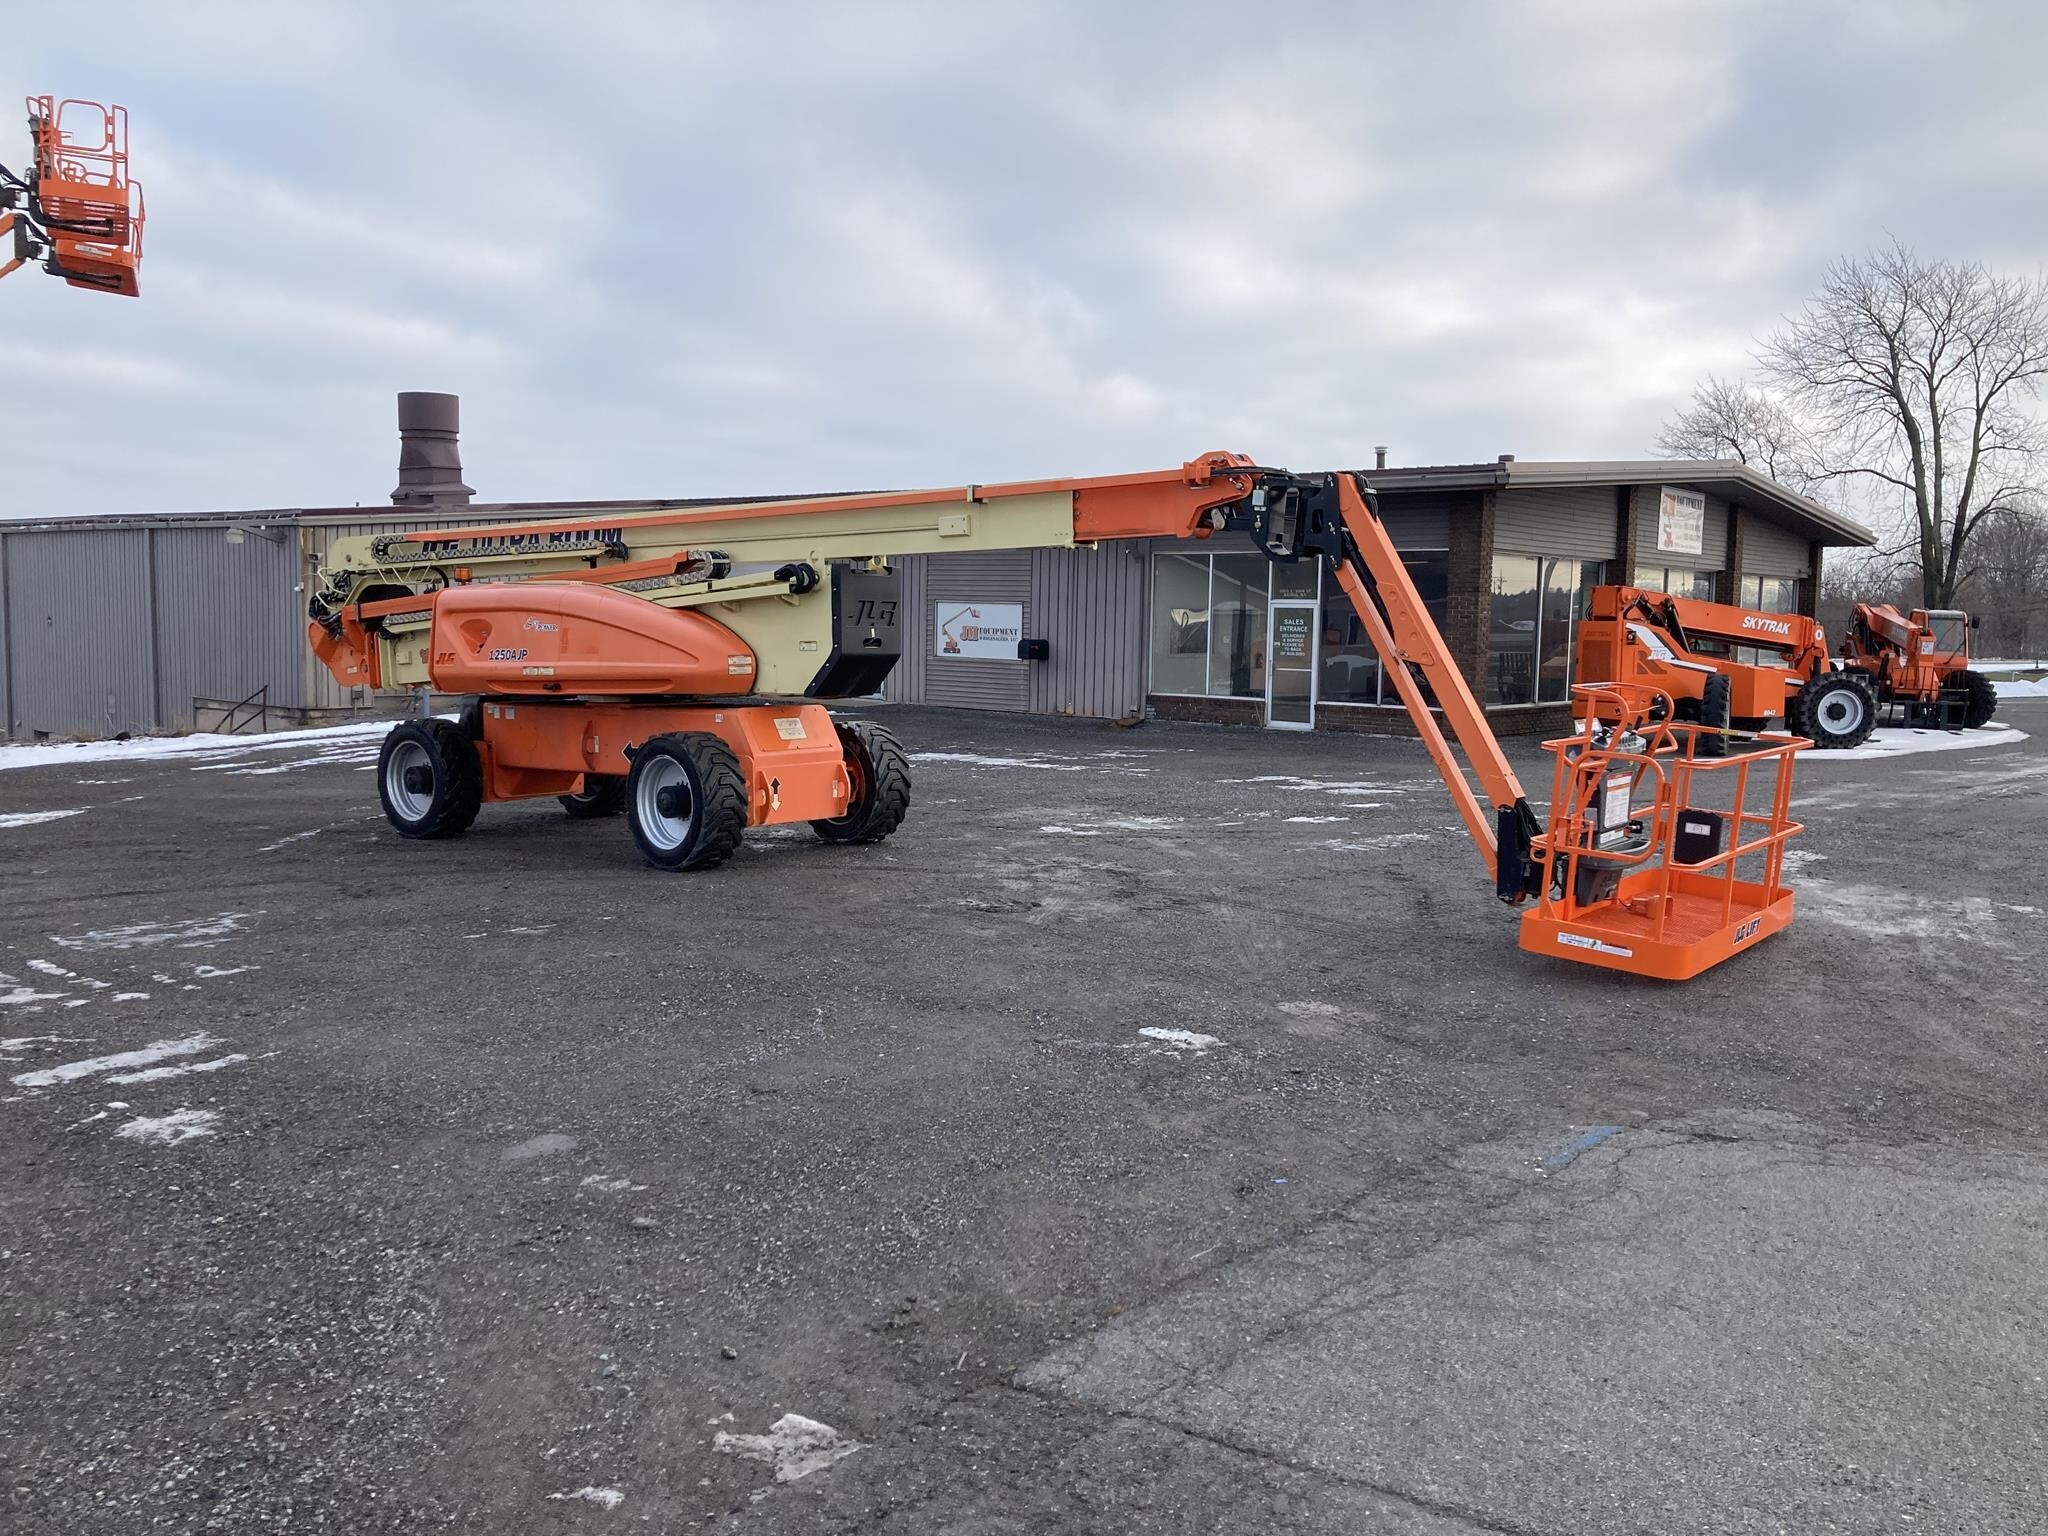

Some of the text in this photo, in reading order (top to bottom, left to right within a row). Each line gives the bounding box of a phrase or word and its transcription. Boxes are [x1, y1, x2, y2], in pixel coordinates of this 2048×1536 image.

[848, 600, 898, 627] JLG
[979, 627, 1018, 636] EQUIPMENT
[1279, 625, 1308, 633] ENTRANCE
[1742, 615, 1792, 635] SKYTRAK
[436, 652, 456, 665] JLG
[488, 648, 529, 661] 1250AJP
